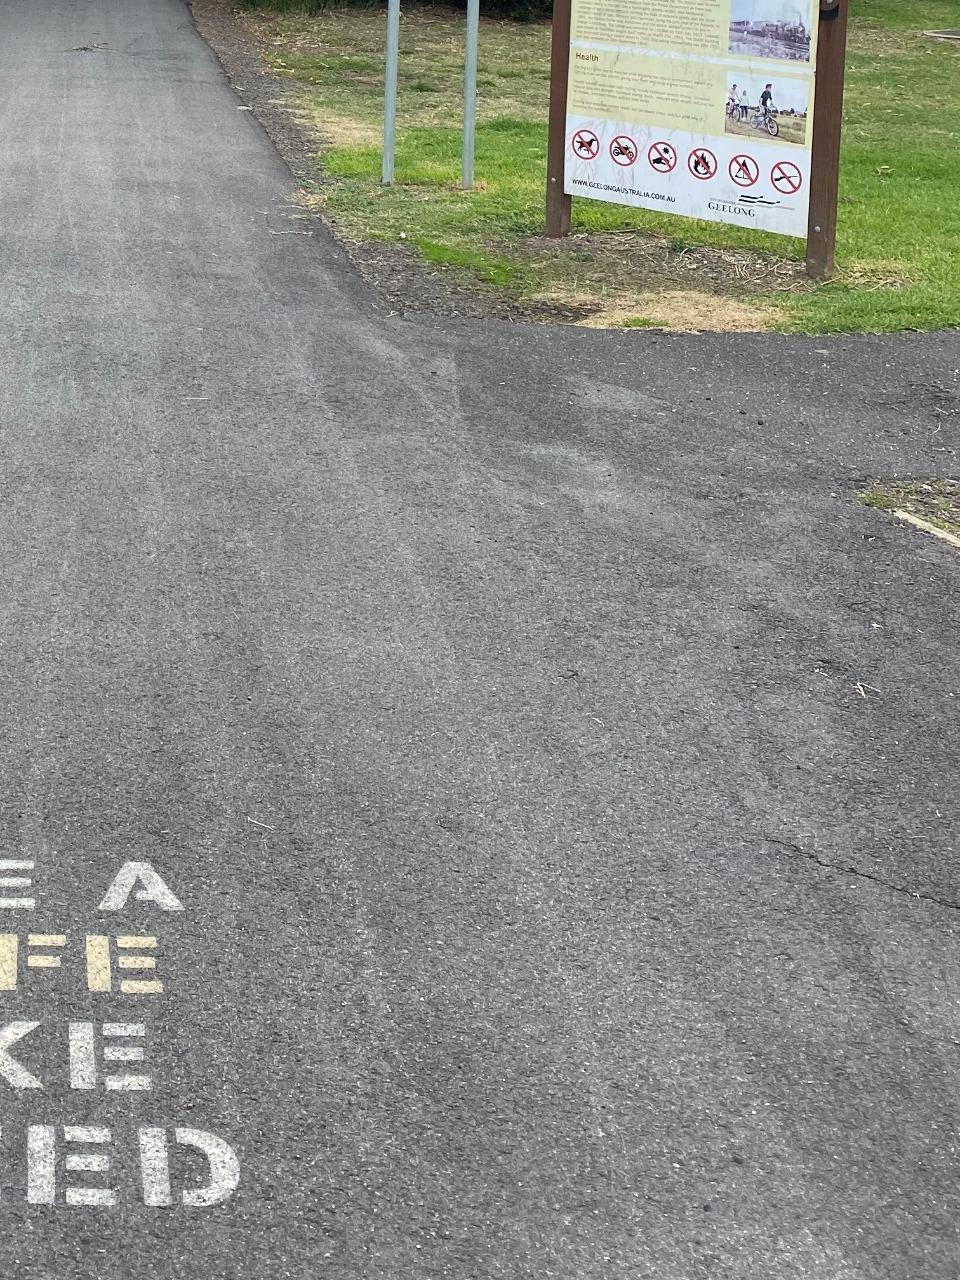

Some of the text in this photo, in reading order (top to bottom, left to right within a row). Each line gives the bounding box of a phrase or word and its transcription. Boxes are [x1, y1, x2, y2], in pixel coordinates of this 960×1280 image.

[575, 52, 599, 62] Health
[572, 179, 676, 202] WWW.GEELONGAUSTRALIA.COM.AU
[708, 202, 756, 218] GEELONG
[98, 861, 186, 911] A
